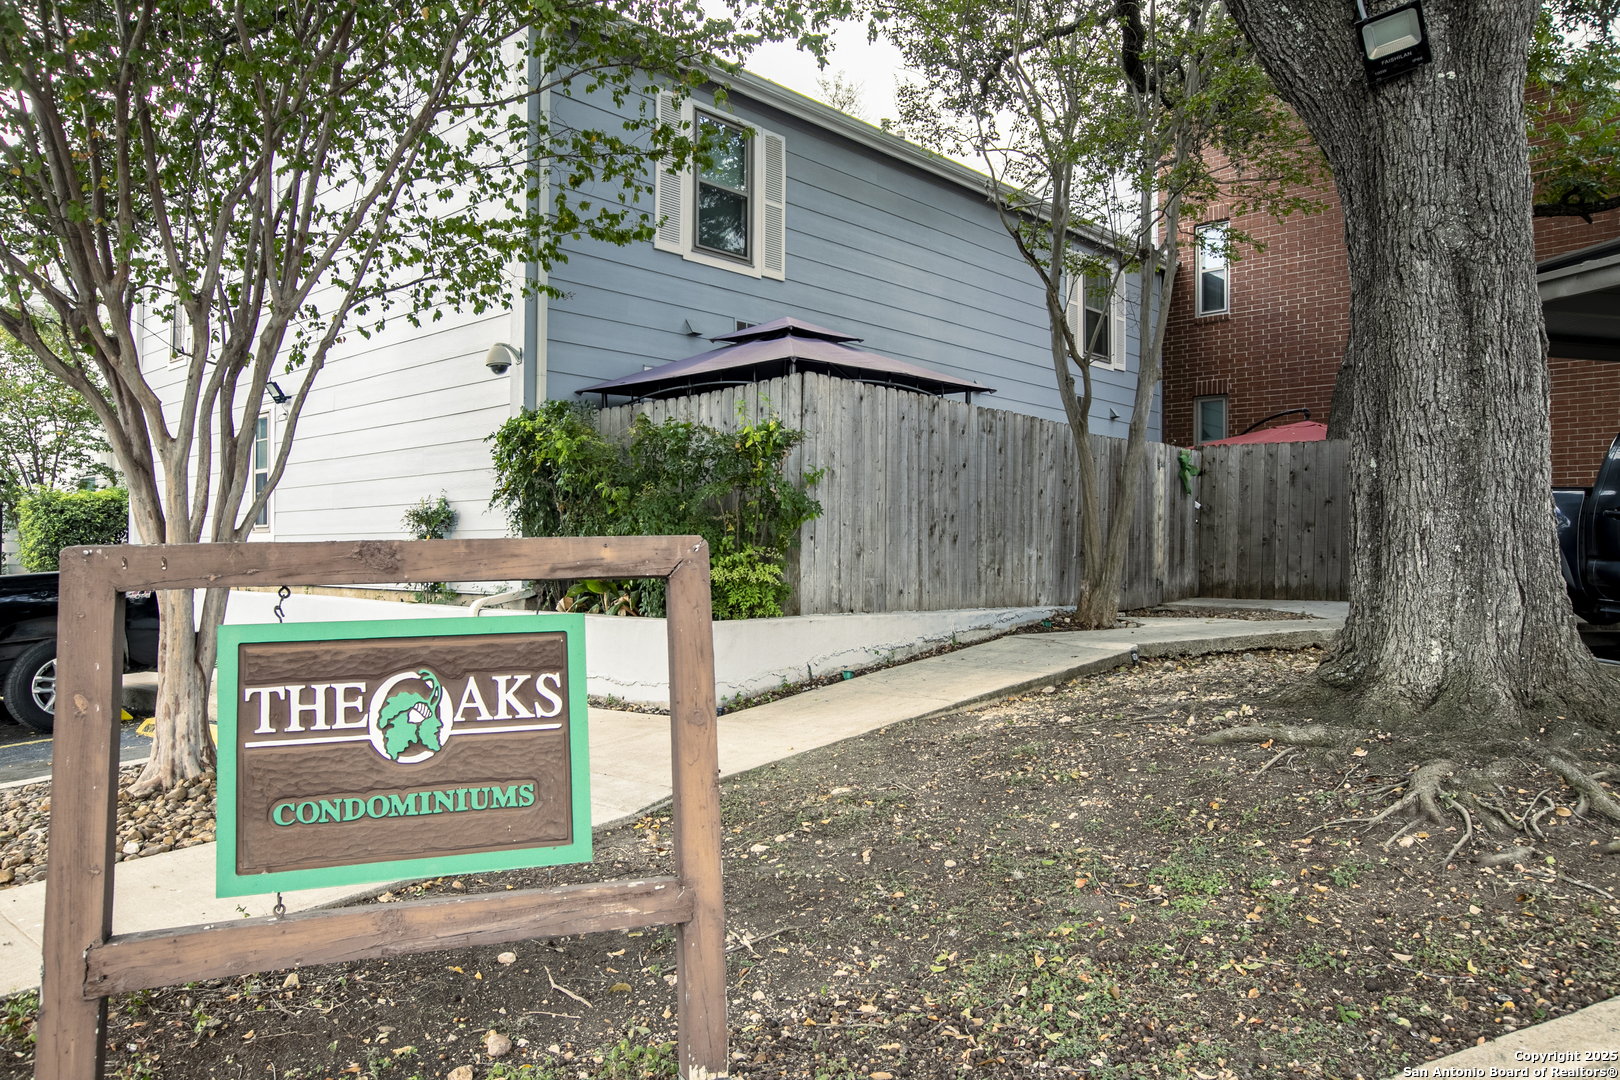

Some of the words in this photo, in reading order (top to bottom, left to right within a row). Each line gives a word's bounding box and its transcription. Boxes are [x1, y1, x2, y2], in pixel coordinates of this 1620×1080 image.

[1381, 51, 1413, 65] FAISHILAN
[244, 682, 368, 734] THE
[272, 784, 535, 826] CONDOMINIUMS
